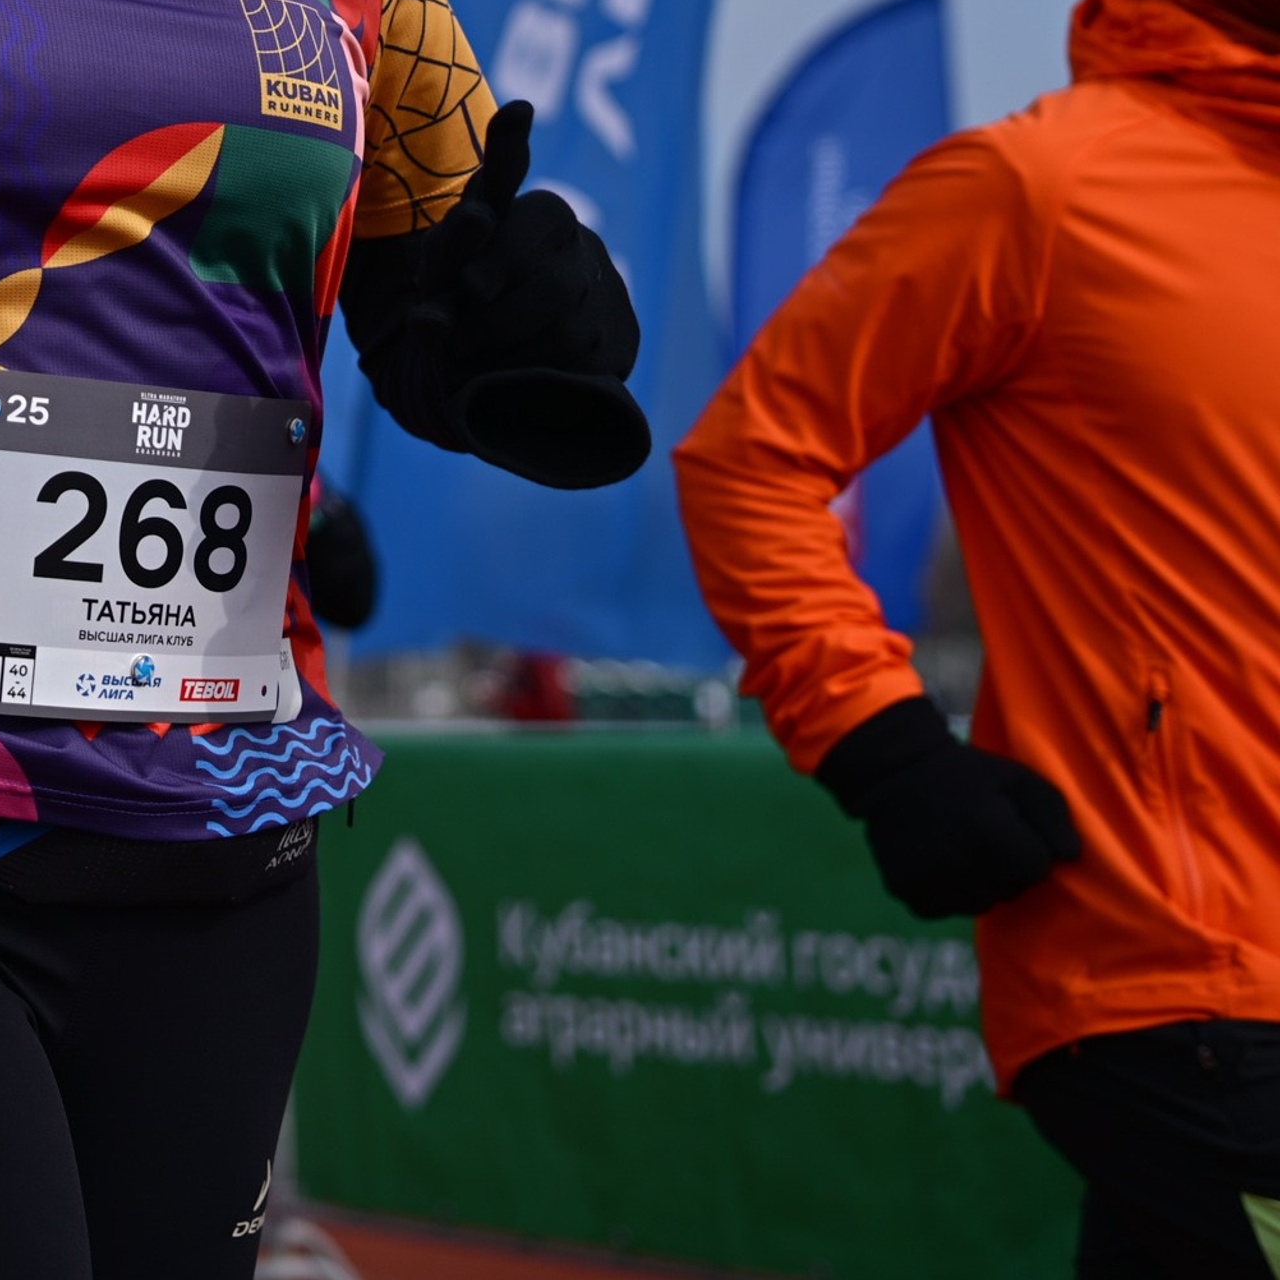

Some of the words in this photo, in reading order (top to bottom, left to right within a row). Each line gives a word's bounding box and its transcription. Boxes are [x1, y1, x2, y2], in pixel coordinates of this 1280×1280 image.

[266, 79, 339, 110] KUBAN
[267, 100, 339, 124] RUNNERS
[6, 394, 50, 426] 25
[131, 401, 191, 429] HARD
[136, 425, 183, 451] RUN
[33, 470, 253, 593] 268
[81, 597, 196, 628] ТАТЬЯНА
[78, 629, 134, 644] ВЫСШАЯ
[136, 633, 164, 646] ЛИГА
[167, 635, 194, 647] КЛУБ
[9, 664, 28, 677] 40
[7, 686, 26, 699] 44
[98, 688, 134, 701] ЛИГА
[183, 681, 236, 700] TEBOIL
